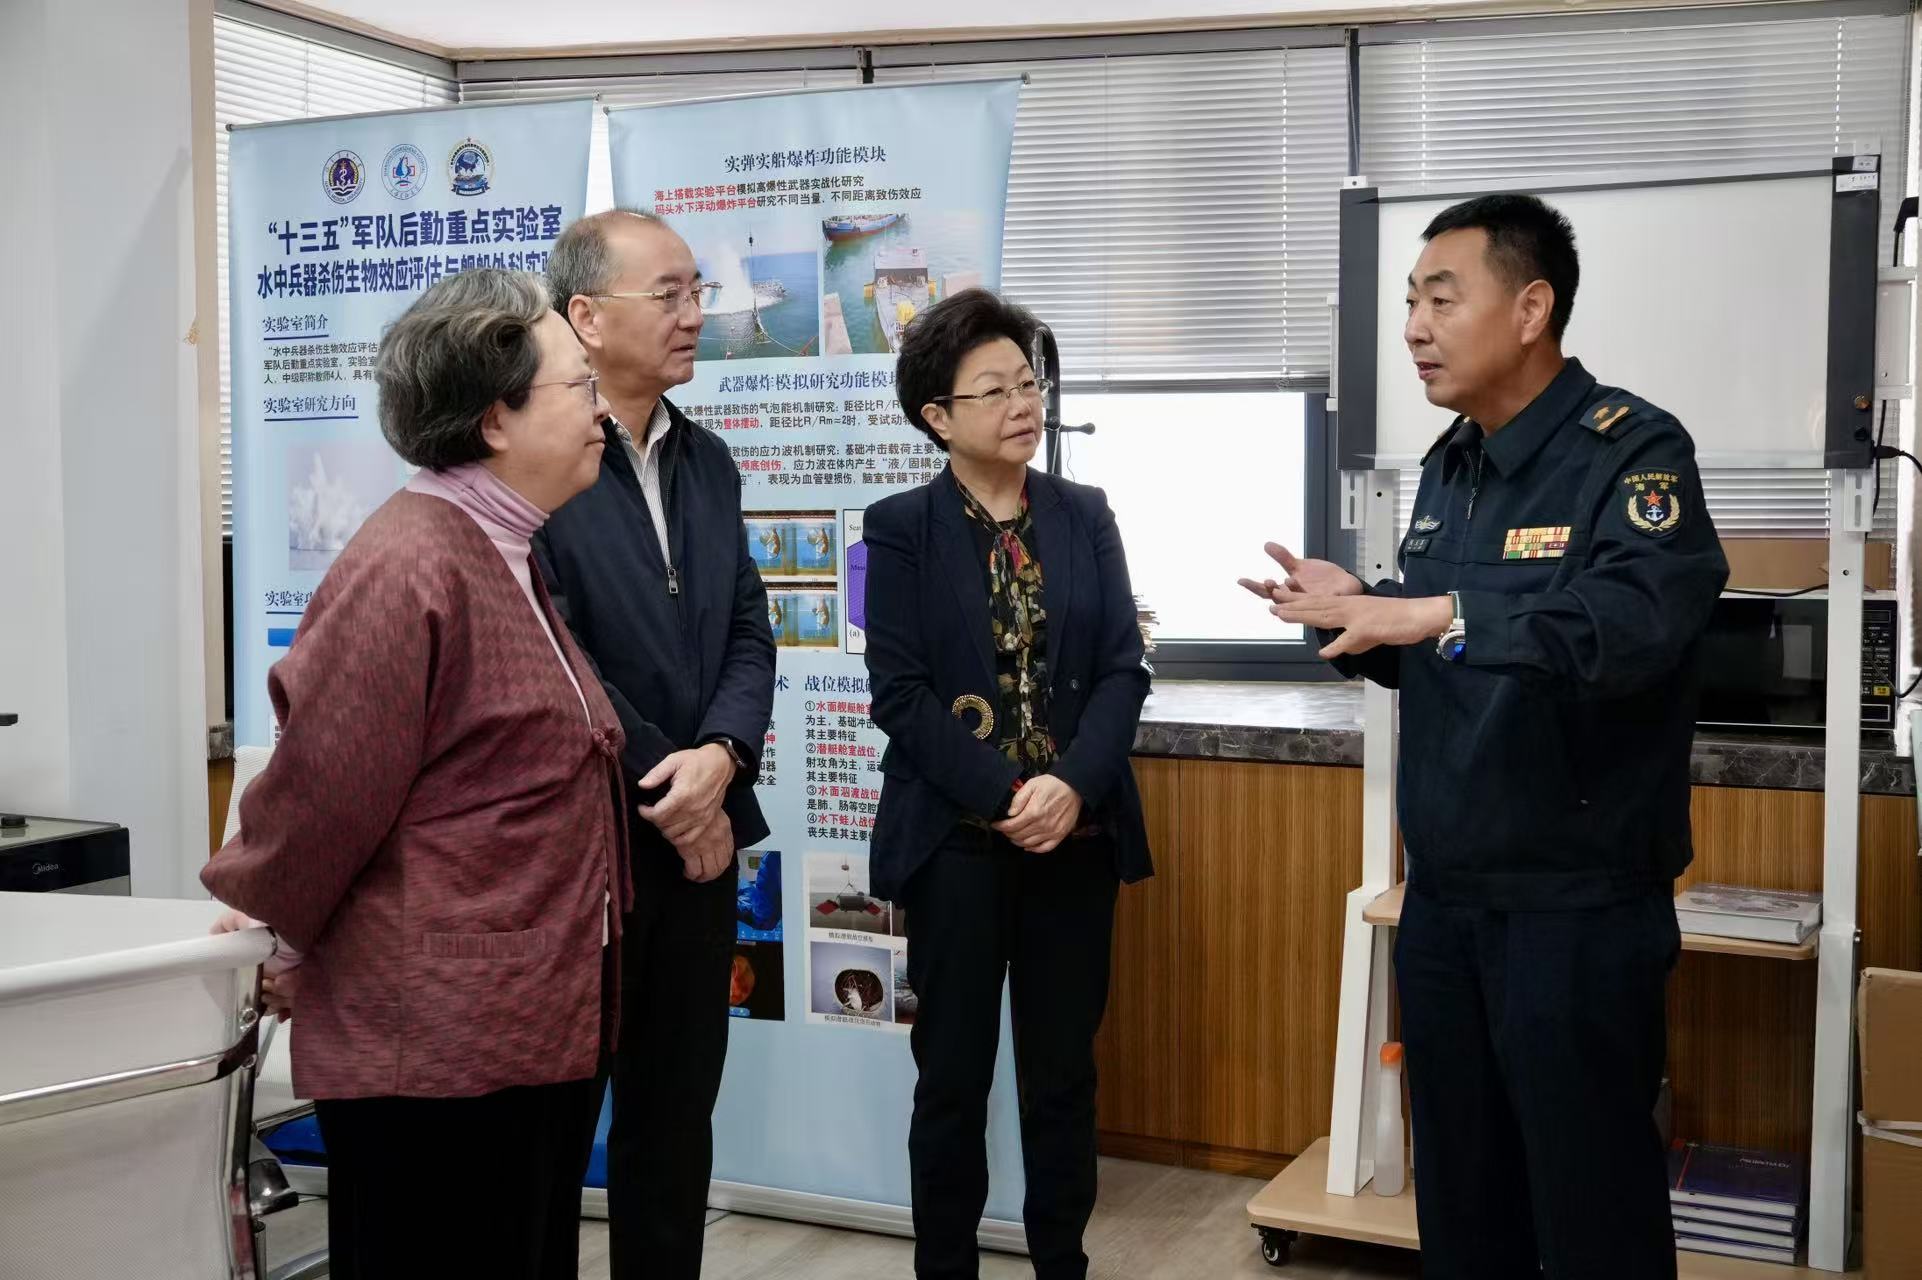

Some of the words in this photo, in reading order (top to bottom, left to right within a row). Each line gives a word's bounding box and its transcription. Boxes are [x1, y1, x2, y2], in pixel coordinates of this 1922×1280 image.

[725, 145, 886, 173] 实弹实船爆炸功能模块
[268, 204, 562, 255] “十三五”军队后勤重点实验室
[263, 314, 328, 333] 实验室简介
[264, 395, 356, 414] 实验室研究方向
[775, 675, 789, 691] 术
[806, 729, 857, 741] 其主要特征
[762, 747, 776, 758] 作
[806, 771, 858, 784] 其主要特征
[807, 799, 880, 814] 是肺、肠等空腔
[33, 863, 59, 874] Midea
